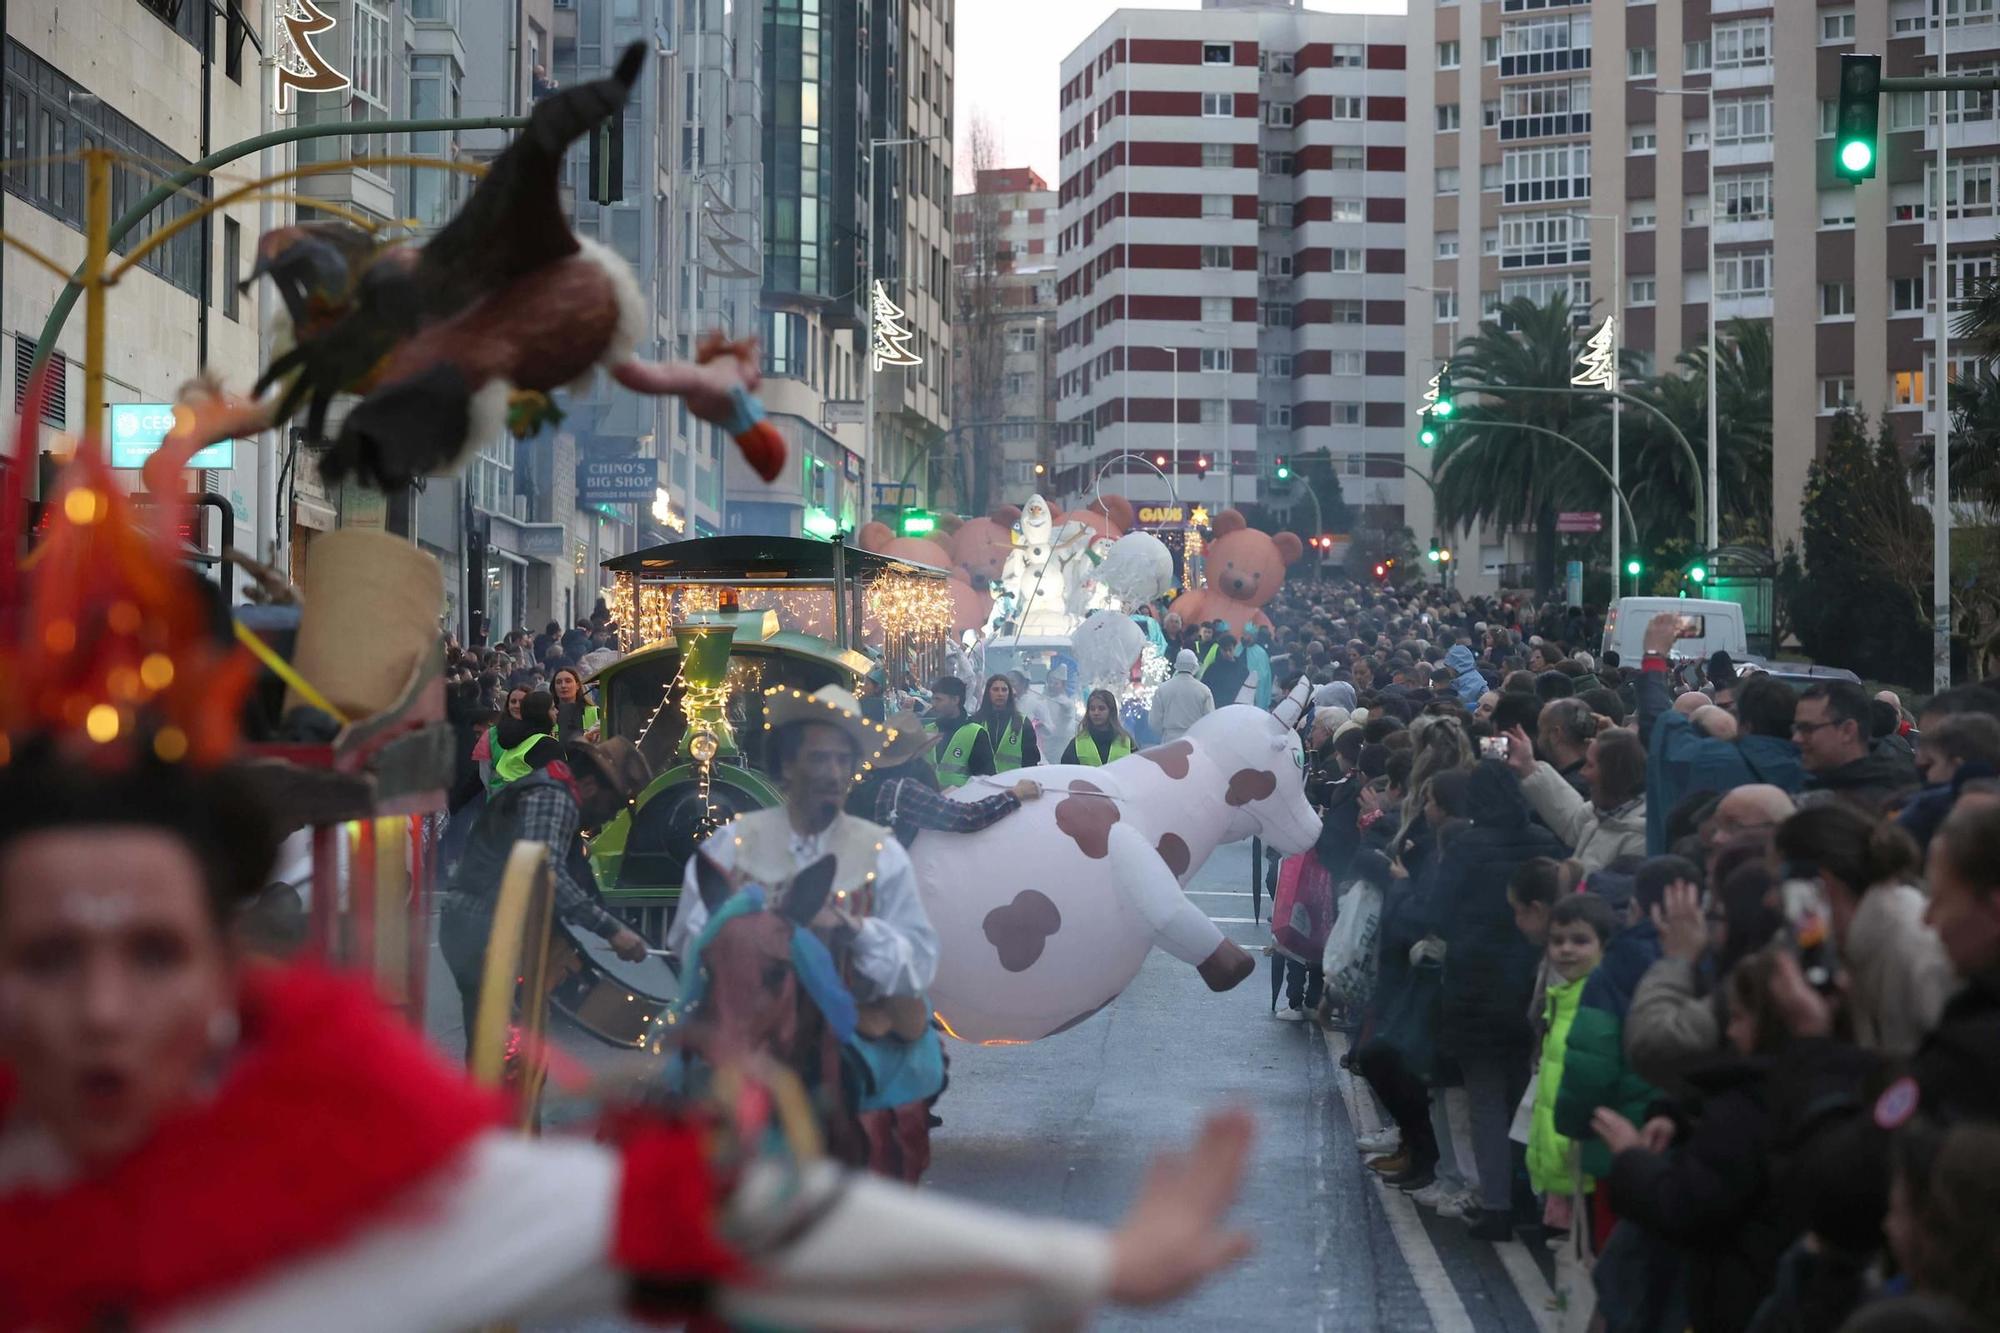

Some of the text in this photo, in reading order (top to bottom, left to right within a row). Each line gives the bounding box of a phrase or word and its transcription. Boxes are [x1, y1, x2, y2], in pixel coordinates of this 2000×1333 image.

[589, 463, 646, 474] CHINO'S
[587, 477, 653, 488] BIG SHOP
